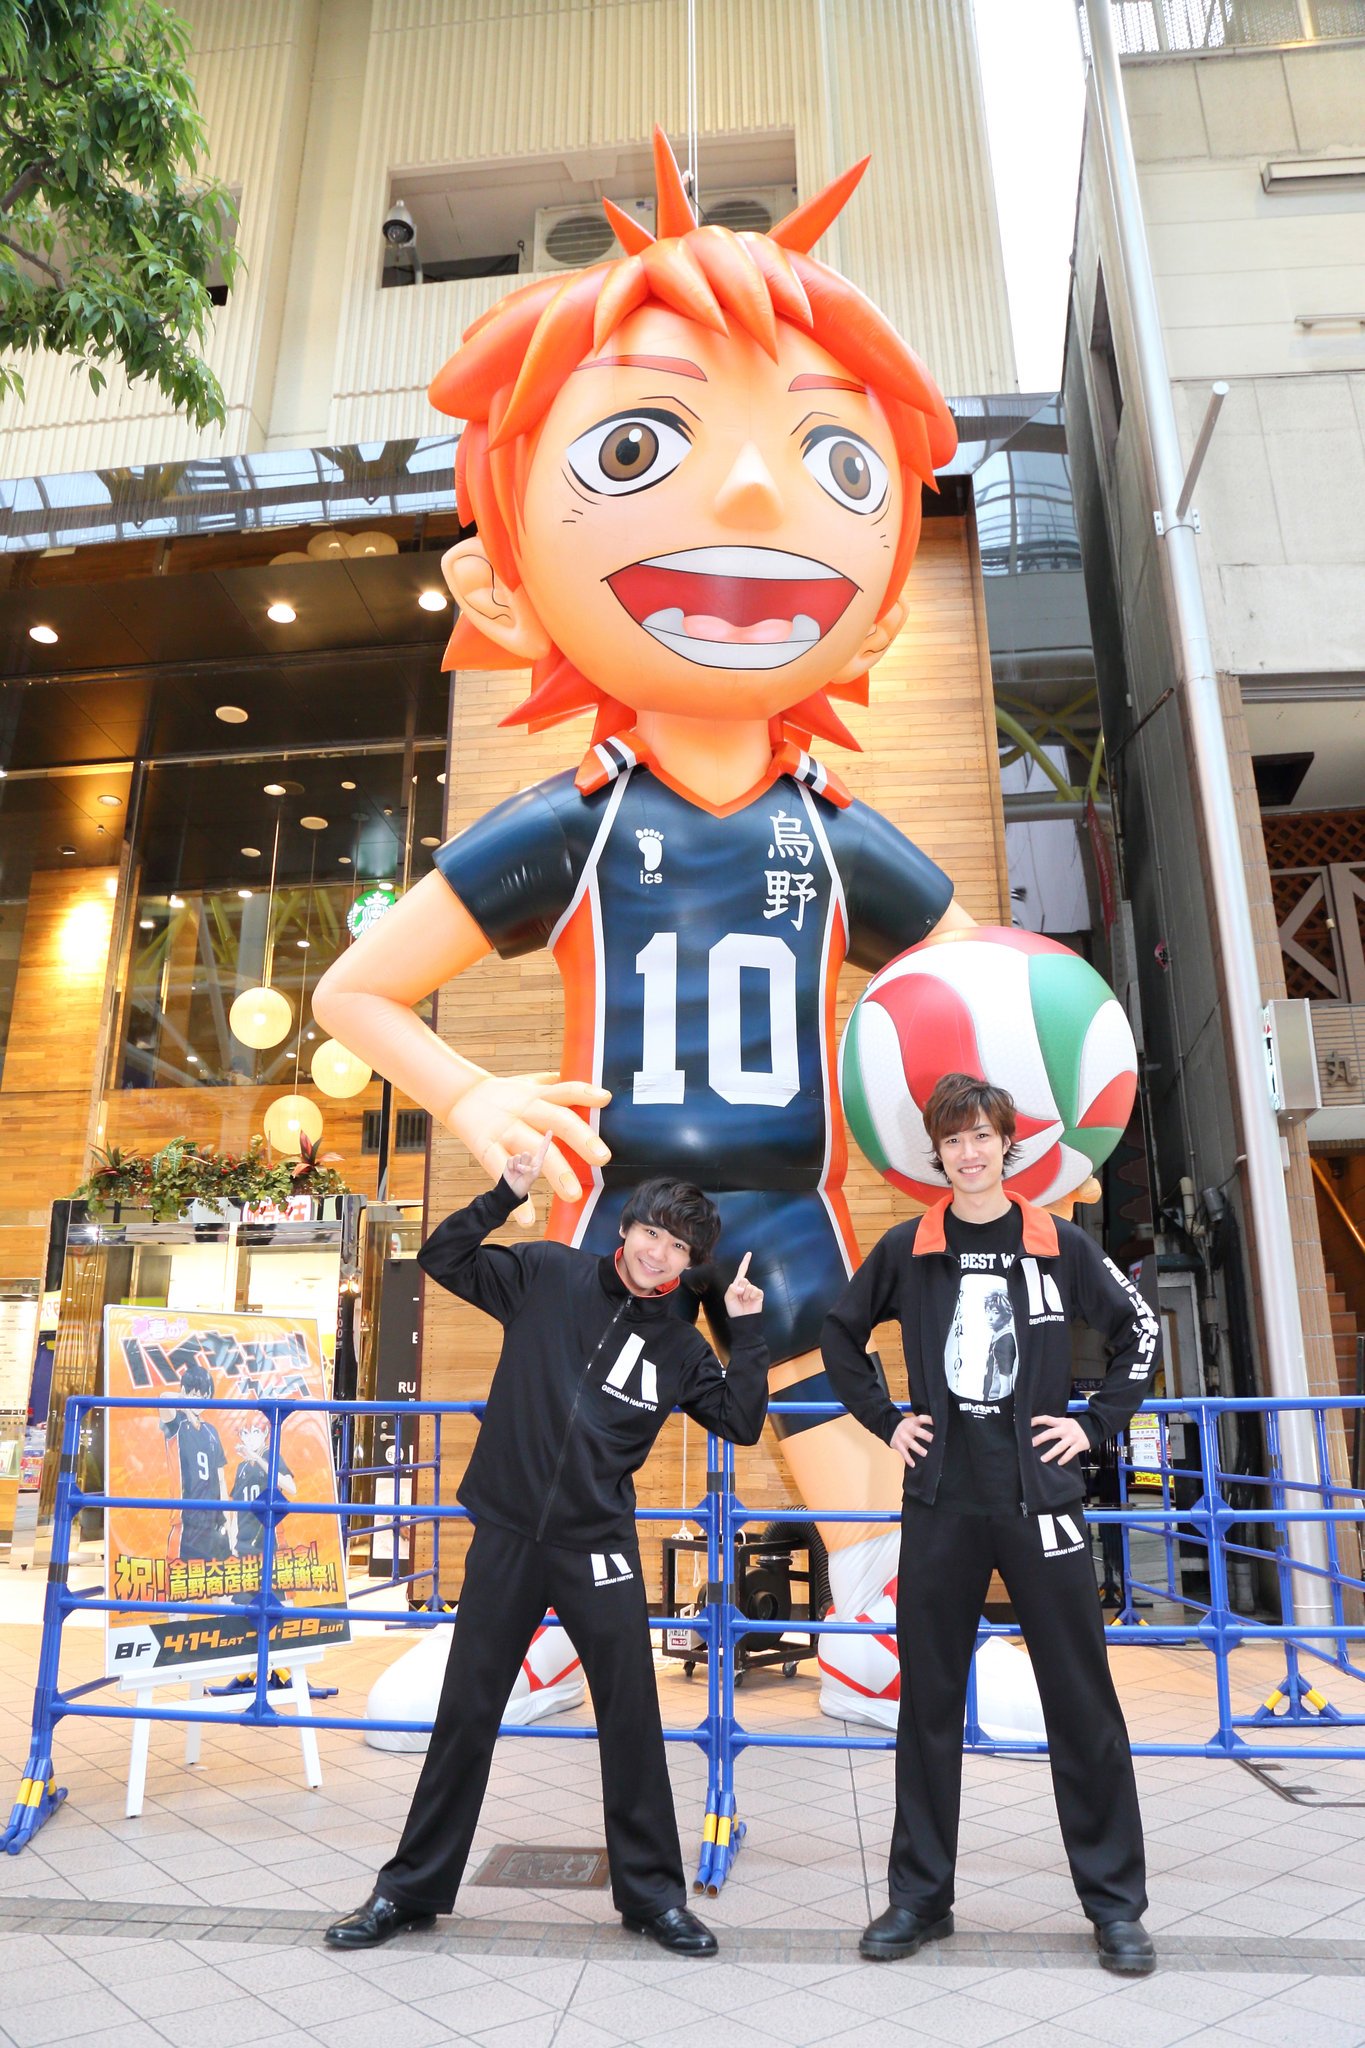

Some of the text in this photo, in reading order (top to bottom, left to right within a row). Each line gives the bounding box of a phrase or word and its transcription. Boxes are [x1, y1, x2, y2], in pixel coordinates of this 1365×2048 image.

[639, 870, 663, 885] ics
[632, 932, 801, 1108] 10
[960, 1253, 997, 1270] BEST
[601, 1384, 630, 1403] GEKIDAN
[196, 1451, 210, 1481] 9
[242, 1484, 261, 1502] 10
[168, 1541, 320, 1577] 全国大会出記念!
